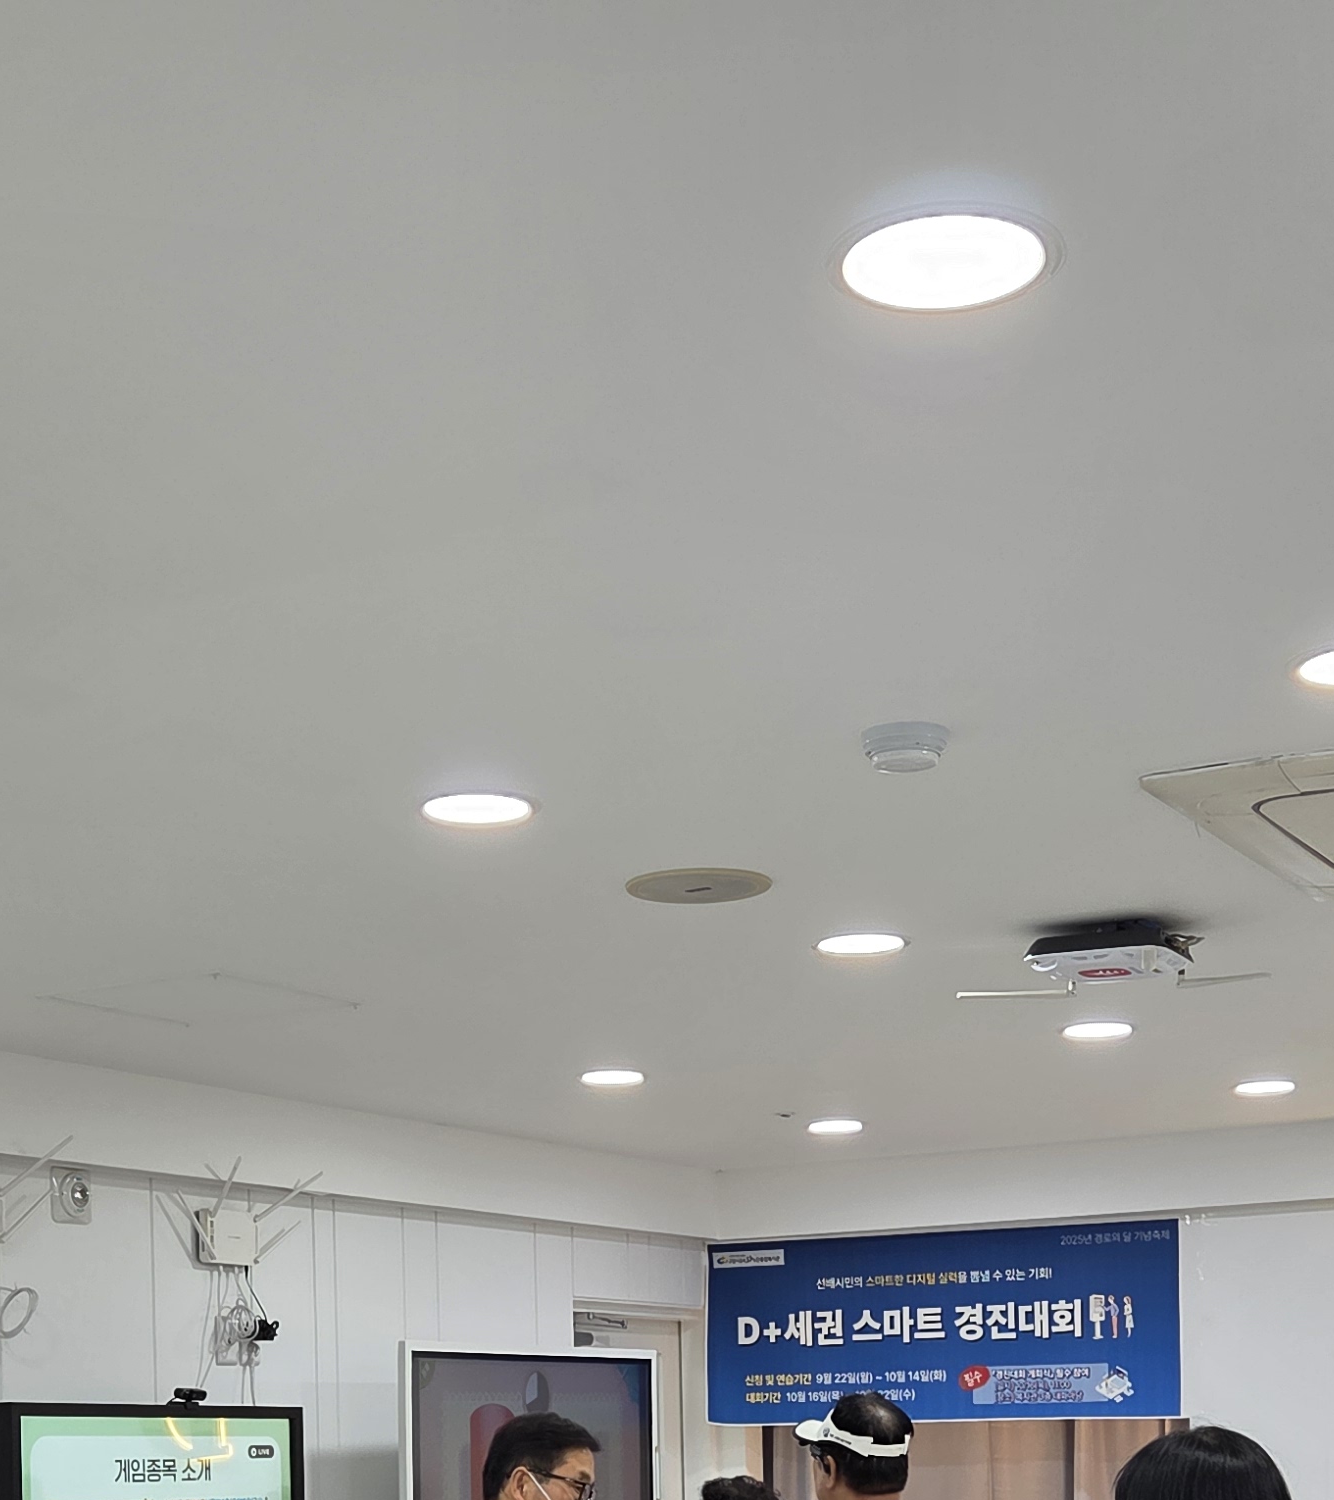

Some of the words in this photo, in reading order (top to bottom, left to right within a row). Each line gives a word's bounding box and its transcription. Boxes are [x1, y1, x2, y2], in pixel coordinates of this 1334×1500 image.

[1060, 1233, 1092, 1245] 2025년
[1122, 1231, 1132, 1242] 달
[1134, 1229, 1170, 1241] 기념축제
[816, 1275, 863, 1290] 선배시민의
[865, 1273, 904, 1287] 스마트한
[906, 1272, 936, 1285] 디지털
[938, 1270, 968, 1284] 실력을
[992, 1269, 1003, 1282] 수
[1005, 1268, 1026, 1281] 있는
[1028, 1267, 1053, 1280] 기회!
[737, 1309, 844, 1347] D+세권
[852, 1306, 946, 1344] 스마트
[954, 1299, 1082, 1341] 경진대회
[776, 1373, 812, 1386] 연습기간
[816, 1373, 832, 1385] 9월
[834, 1371, 873, 1385] 22일(월)
[885, 1370, 906, 1383] 10월
[907, 1369, 947, 1383] 14일(화)
[964, 1370, 983, 1387] 필수
[745, 1391, 782, 1404] 대회기간
[786, 1391, 806, 1403] 10월
[114, 1458, 178, 1483] 게임종목
[181, 1458, 212, 1482] 소개
